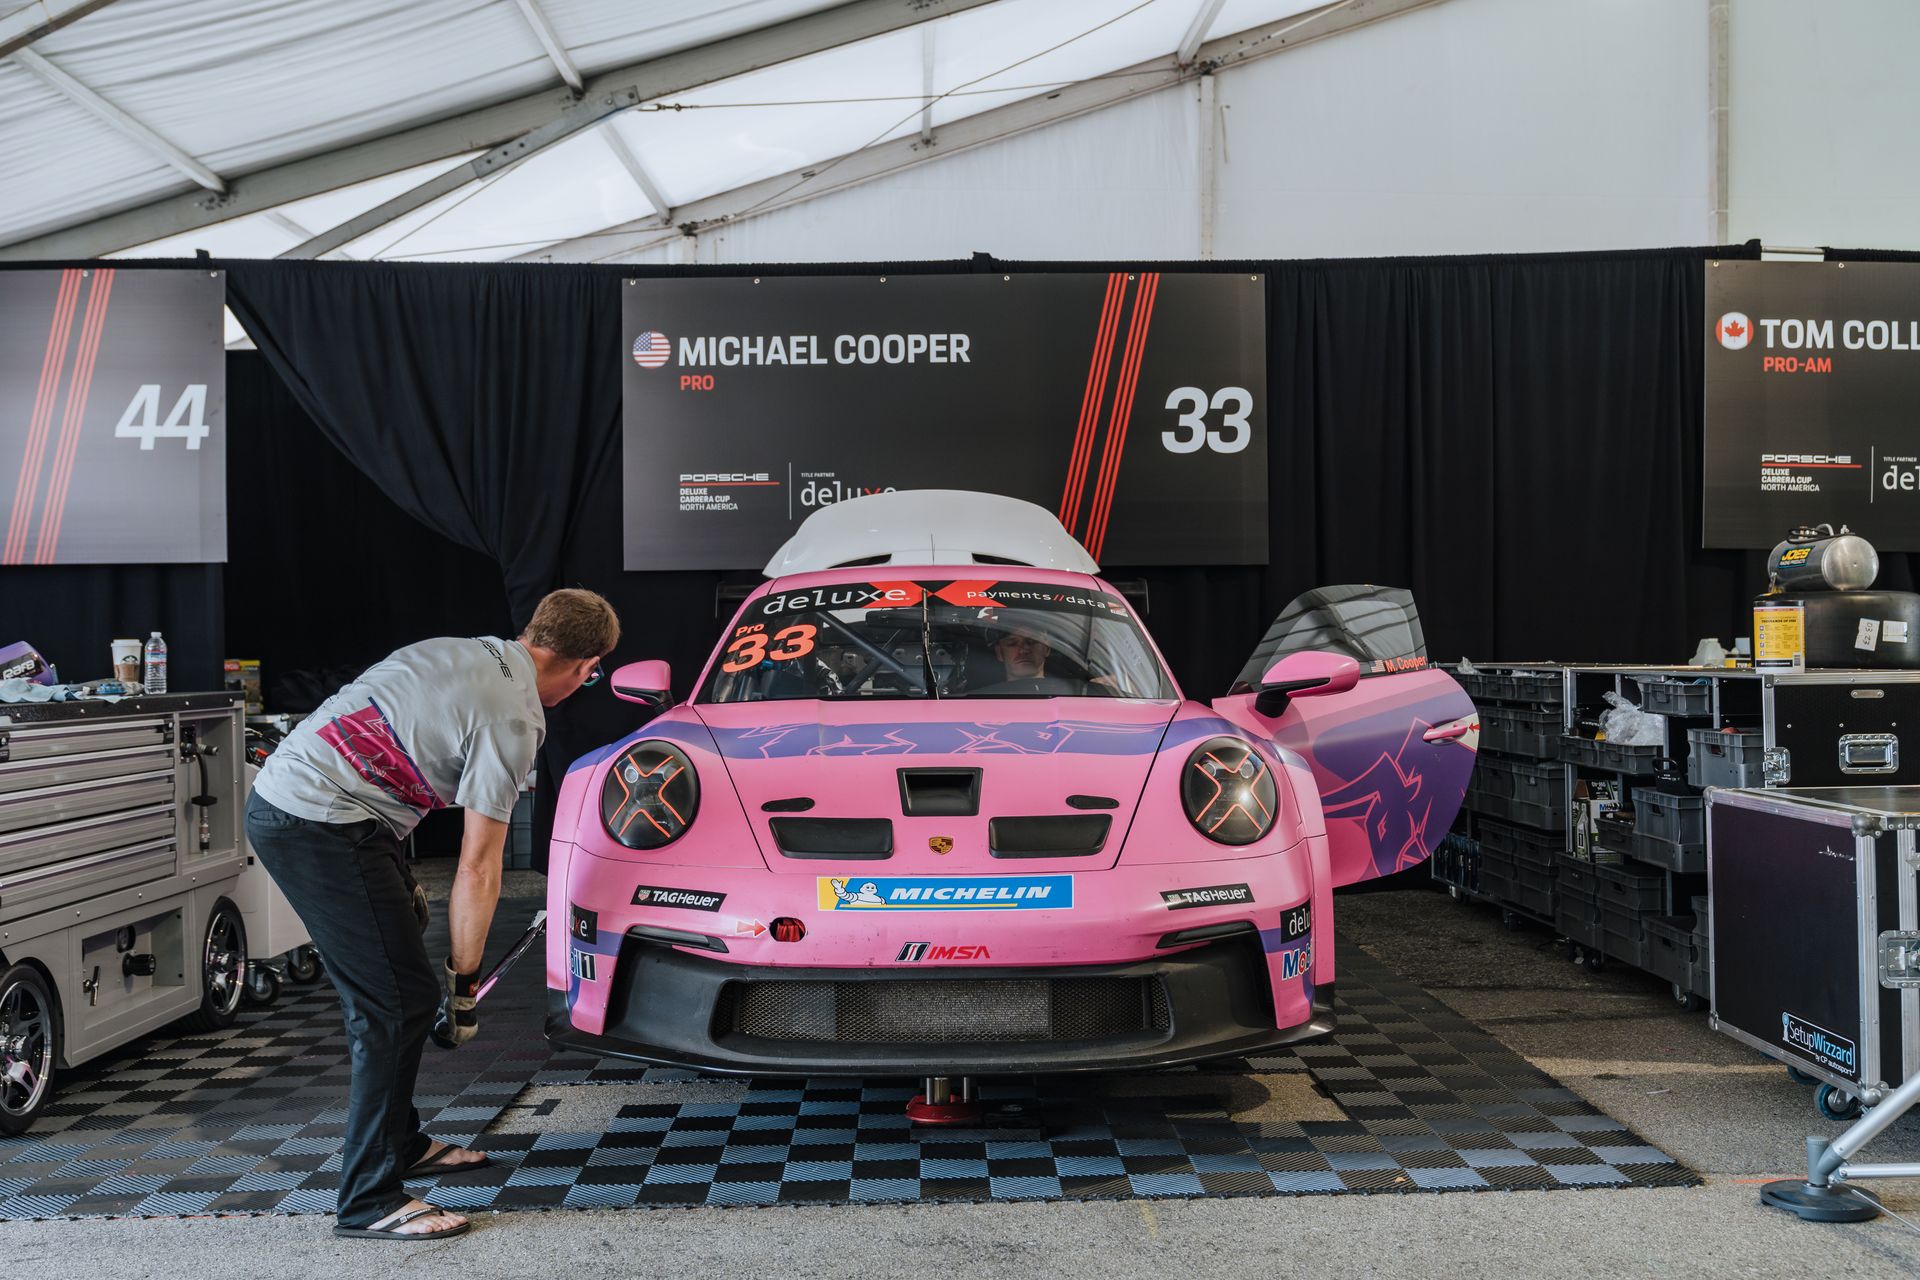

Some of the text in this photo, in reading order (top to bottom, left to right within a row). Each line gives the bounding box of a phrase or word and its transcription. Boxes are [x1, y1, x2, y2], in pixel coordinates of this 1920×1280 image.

[1760, 319, 1920, 350] TOM COLL
[678, 334, 971, 366] MICHAEL COOPER
[1763, 356, 1832, 373] PRO-AM
[680, 375, 715, 390] PRO
[115, 384, 209, 450] 44
[1162, 386, 1254, 454] 33
[1761, 454, 1851, 463] PORSCHE
[680, 473, 769, 482] PORSCHE
[1761, 468, 1790, 476] DELUXE
[1787, 484, 1820, 492] AMERICA
[680, 495, 731, 503] CARRERA CUP
[680, 503, 739, 511] NORTH AMERICA
[1781, 548, 1811, 561] JOES
[763, 589, 907, 615] deluxe
[735, 623, 765, 637] Pro
[722, 624, 817, 673] 33
[1396, 656, 1427, 671] Cooper
[889, 886, 1052, 901] MICHELIN
[927, 945, 991, 961] IMSA
[1789, 1020, 1853, 1066] SetupWizzard
